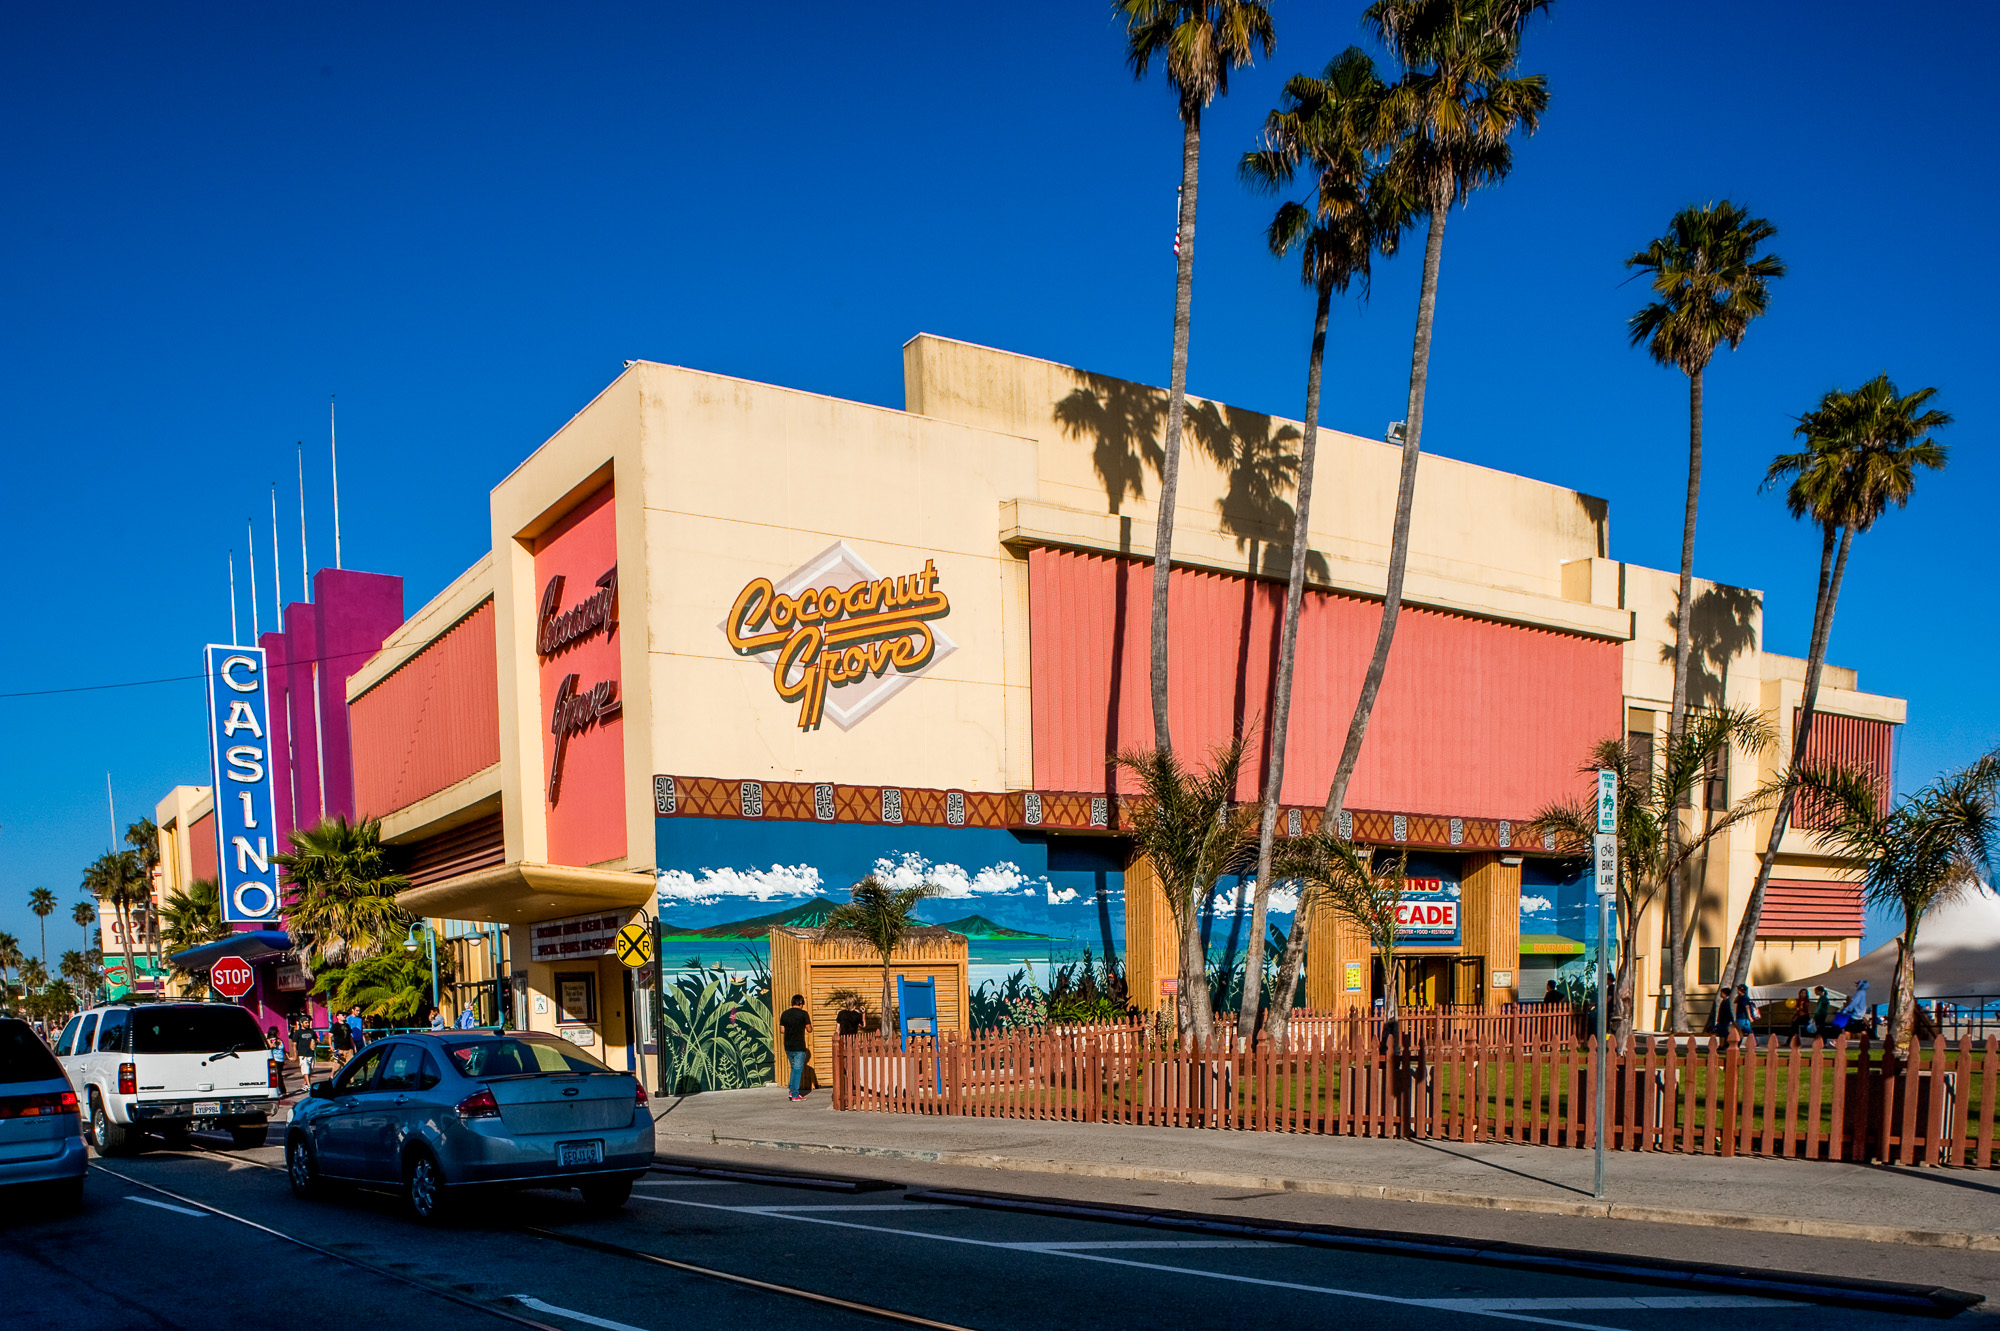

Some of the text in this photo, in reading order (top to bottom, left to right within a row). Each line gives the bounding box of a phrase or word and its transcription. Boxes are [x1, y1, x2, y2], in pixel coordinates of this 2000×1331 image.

[726, 558, 949, 653] Cocoanut
[773, 619, 934, 730] Grove
[549, 673, 622, 803] Grove
[1602, 773, 1616, 781] POLICE
[221, 655, 276, 918] CASINO
[1602, 819, 1615, 827] ROUTE
[1602, 860, 1613, 871] BIKE
[1601, 874, 1614, 885] LANE
[618, 939, 650, 952] R R
[1533, 943, 1573, 953] BEVERAGES
[215, 969, 251, 985] STOP
